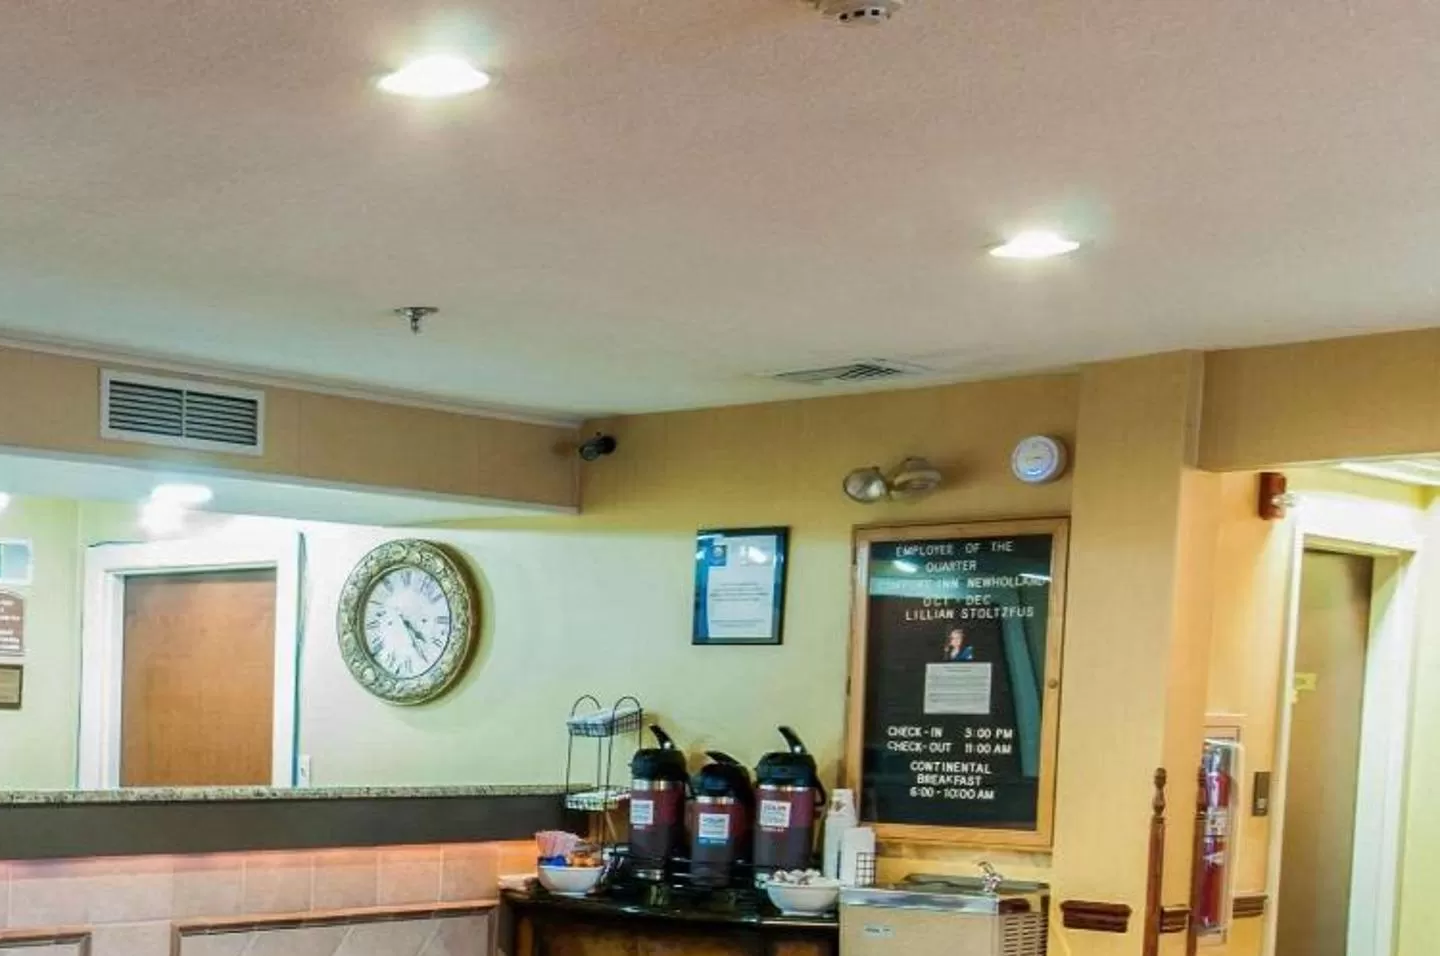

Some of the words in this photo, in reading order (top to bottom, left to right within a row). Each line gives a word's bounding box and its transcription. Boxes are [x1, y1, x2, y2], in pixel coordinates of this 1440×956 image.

[896, 544, 954, 557] EMPLOYEE
[965, 543, 980, 554] OF
[992, 541, 1014, 552] THE
[925, 560, 977, 573] QUARTER
[923, 596, 949, 607] OCT
[965, 595, 992, 606] DEC
[905, 608, 954, 621] LILLIAN
[961, 606, 1034, 619] STOLTZFUS
[995, 728, 1013, 739] PM
[993, 743, 1012, 754] AM
[910, 760, 992, 774] CONTINENTAL
[917, 773, 982, 786] BREAKFAST
[977, 789, 995, 800] AM
